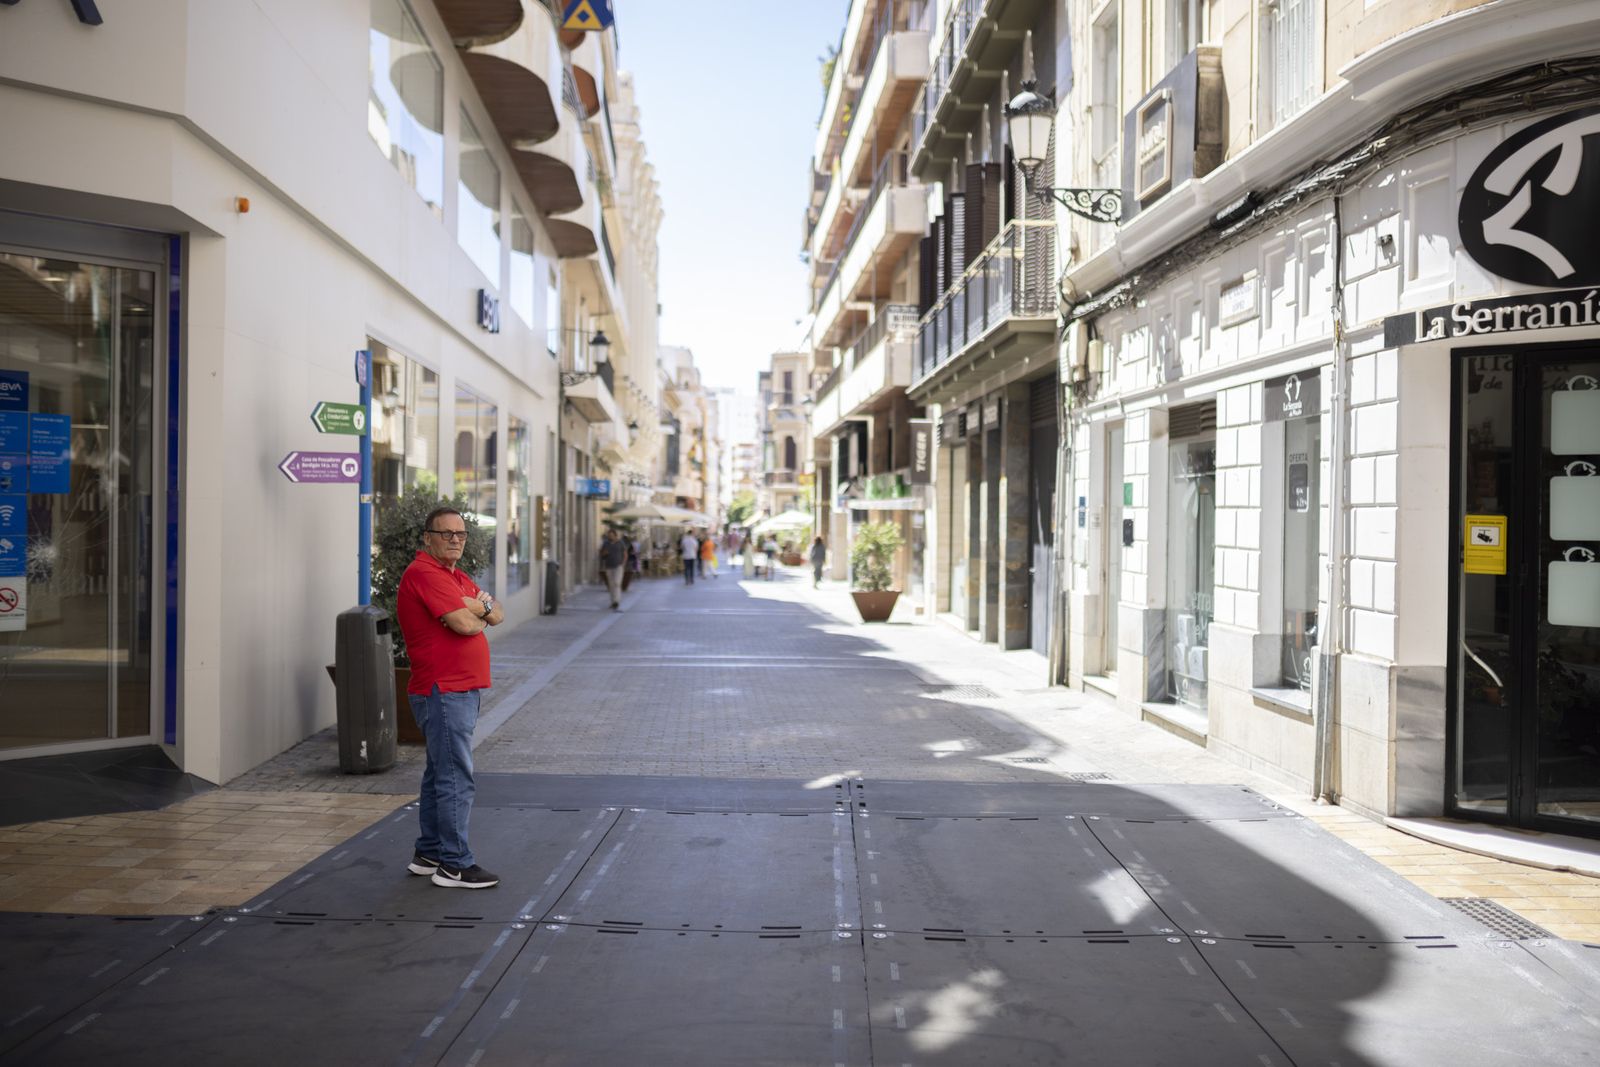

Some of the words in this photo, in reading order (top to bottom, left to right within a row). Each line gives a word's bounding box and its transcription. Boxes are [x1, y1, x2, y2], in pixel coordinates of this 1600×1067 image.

[1414, 310, 1446, 343] La
[1451, 290, 1600, 337] Serraní
[0, 382, 22, 391] BVA
[915, 431, 927, 473] TIGER
[1288, 452, 1308, 462] OFERTA
